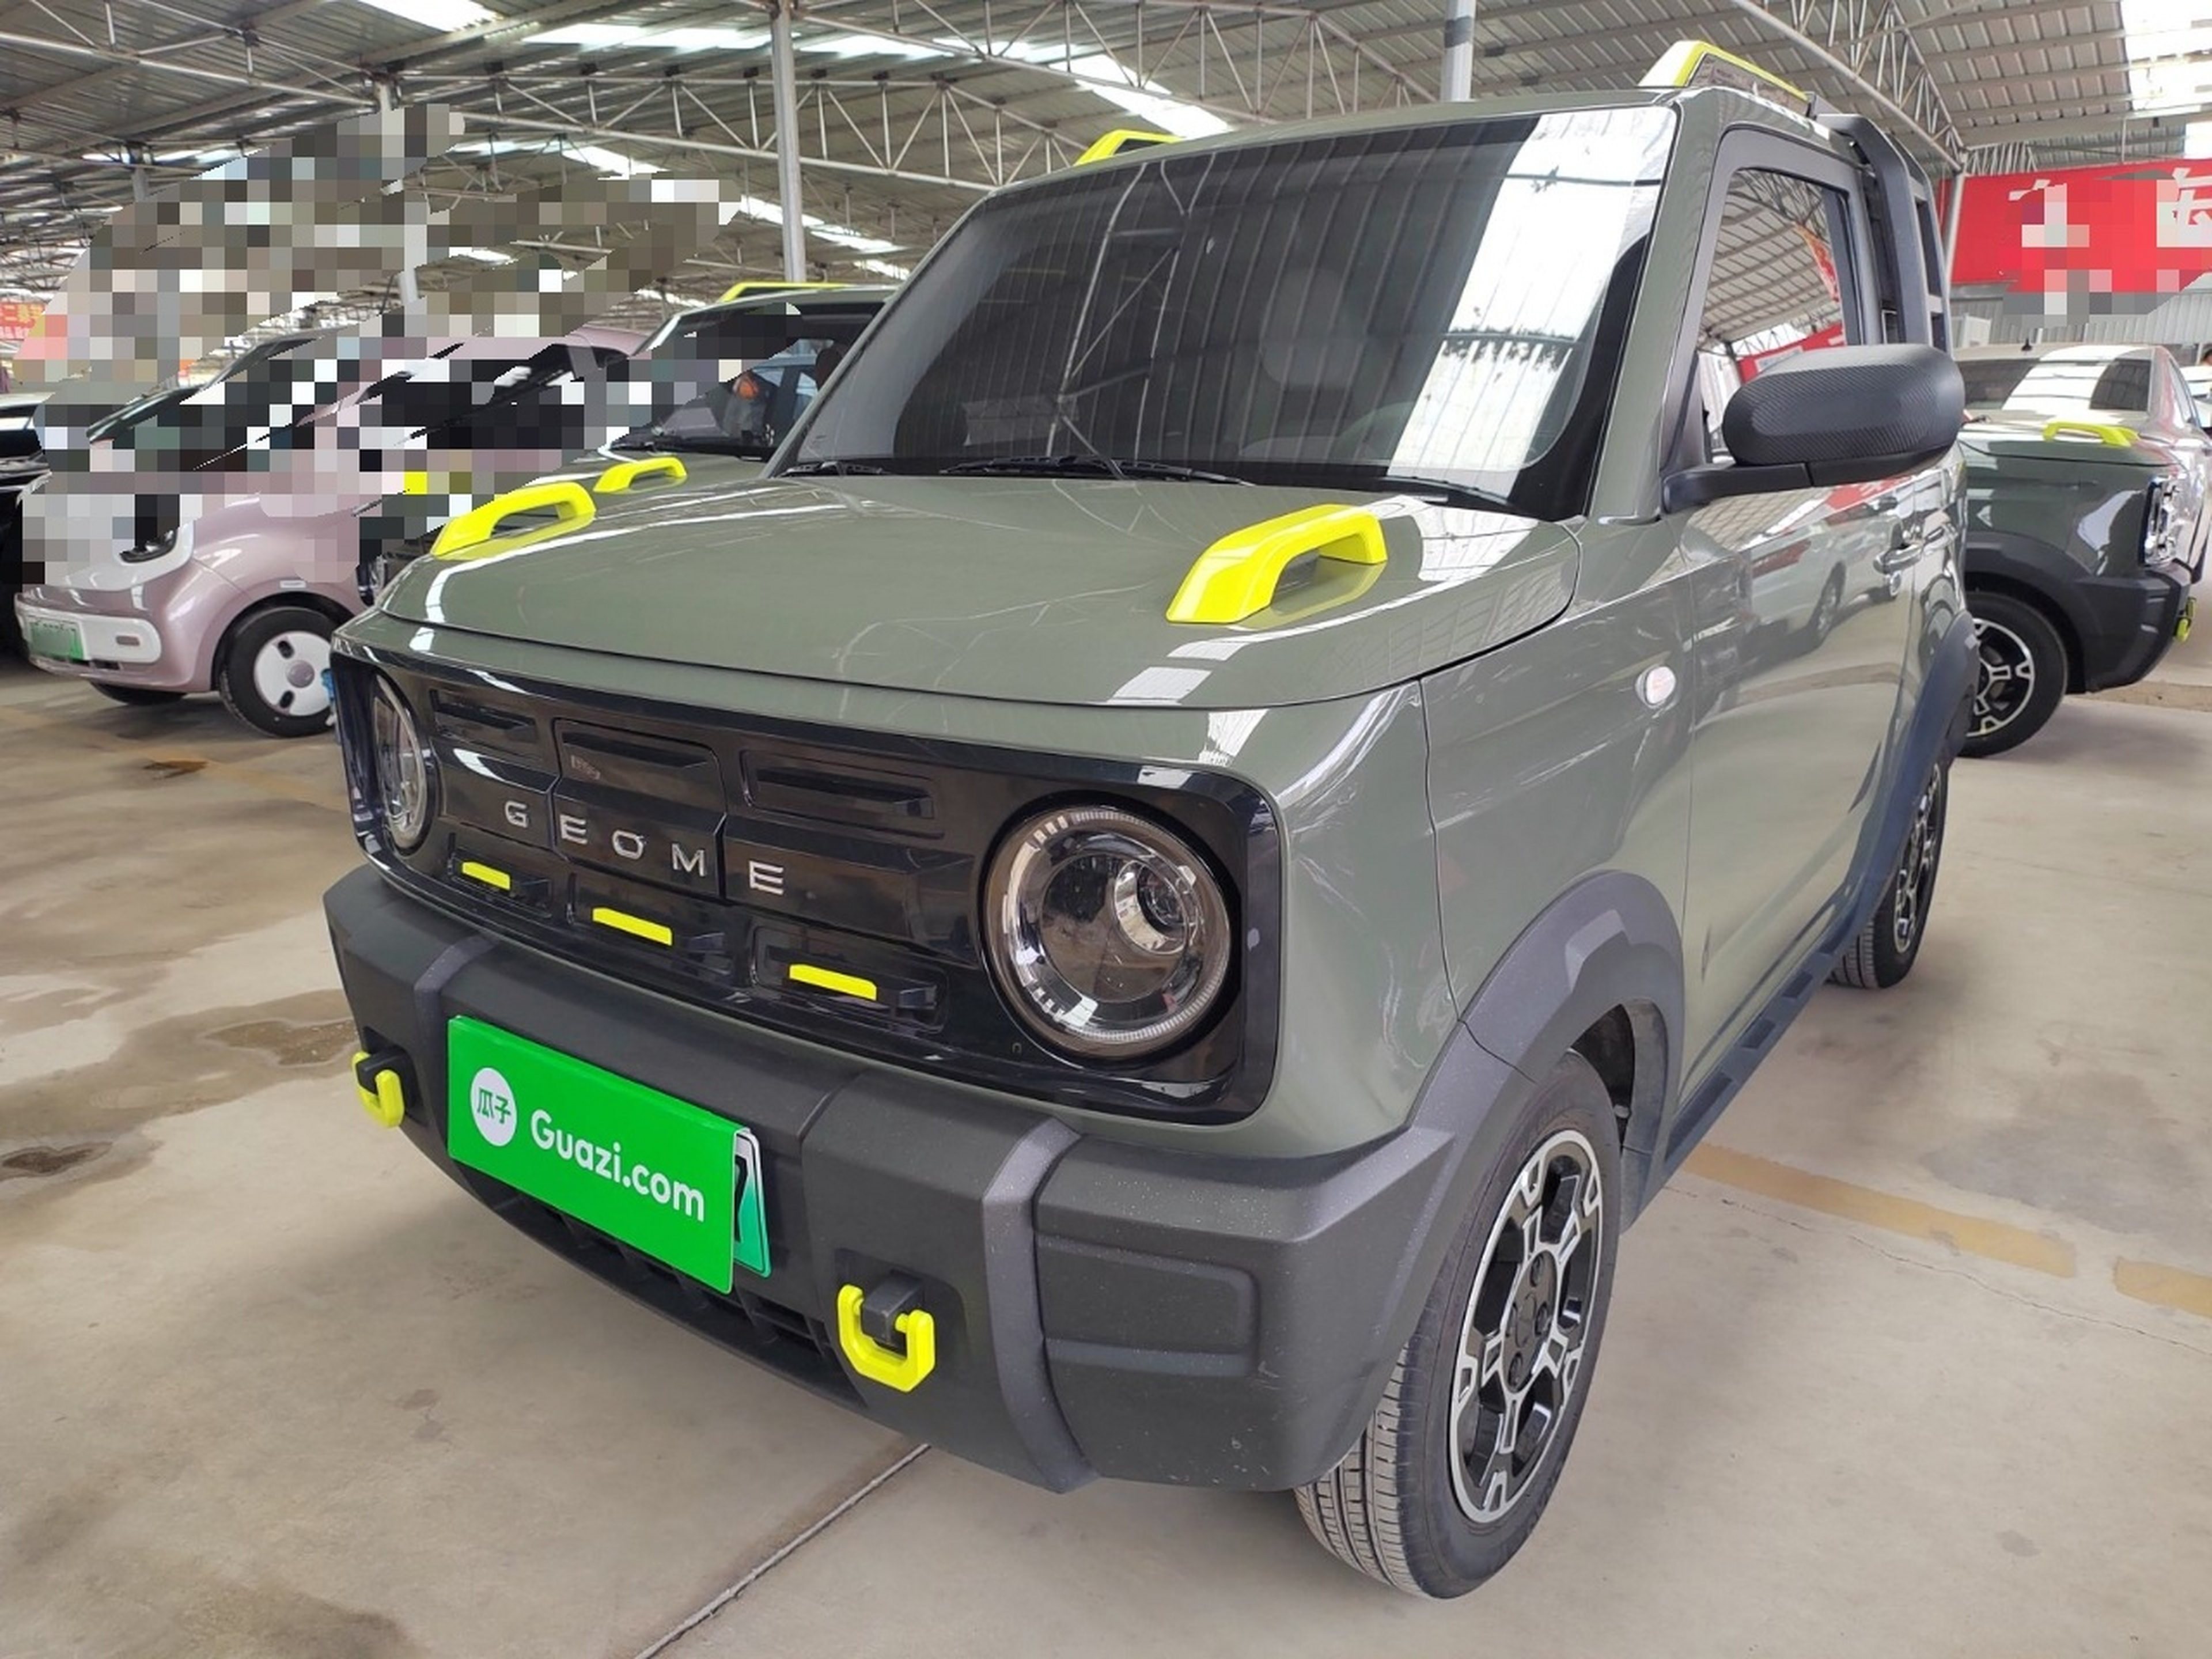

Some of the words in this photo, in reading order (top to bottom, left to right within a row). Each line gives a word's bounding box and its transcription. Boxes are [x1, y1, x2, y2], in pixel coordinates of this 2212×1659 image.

[505, 800, 784, 895] GEOME
[476, 1088, 511, 1124] 瓜子
[530, 1108, 704, 1222] Guazi.com
